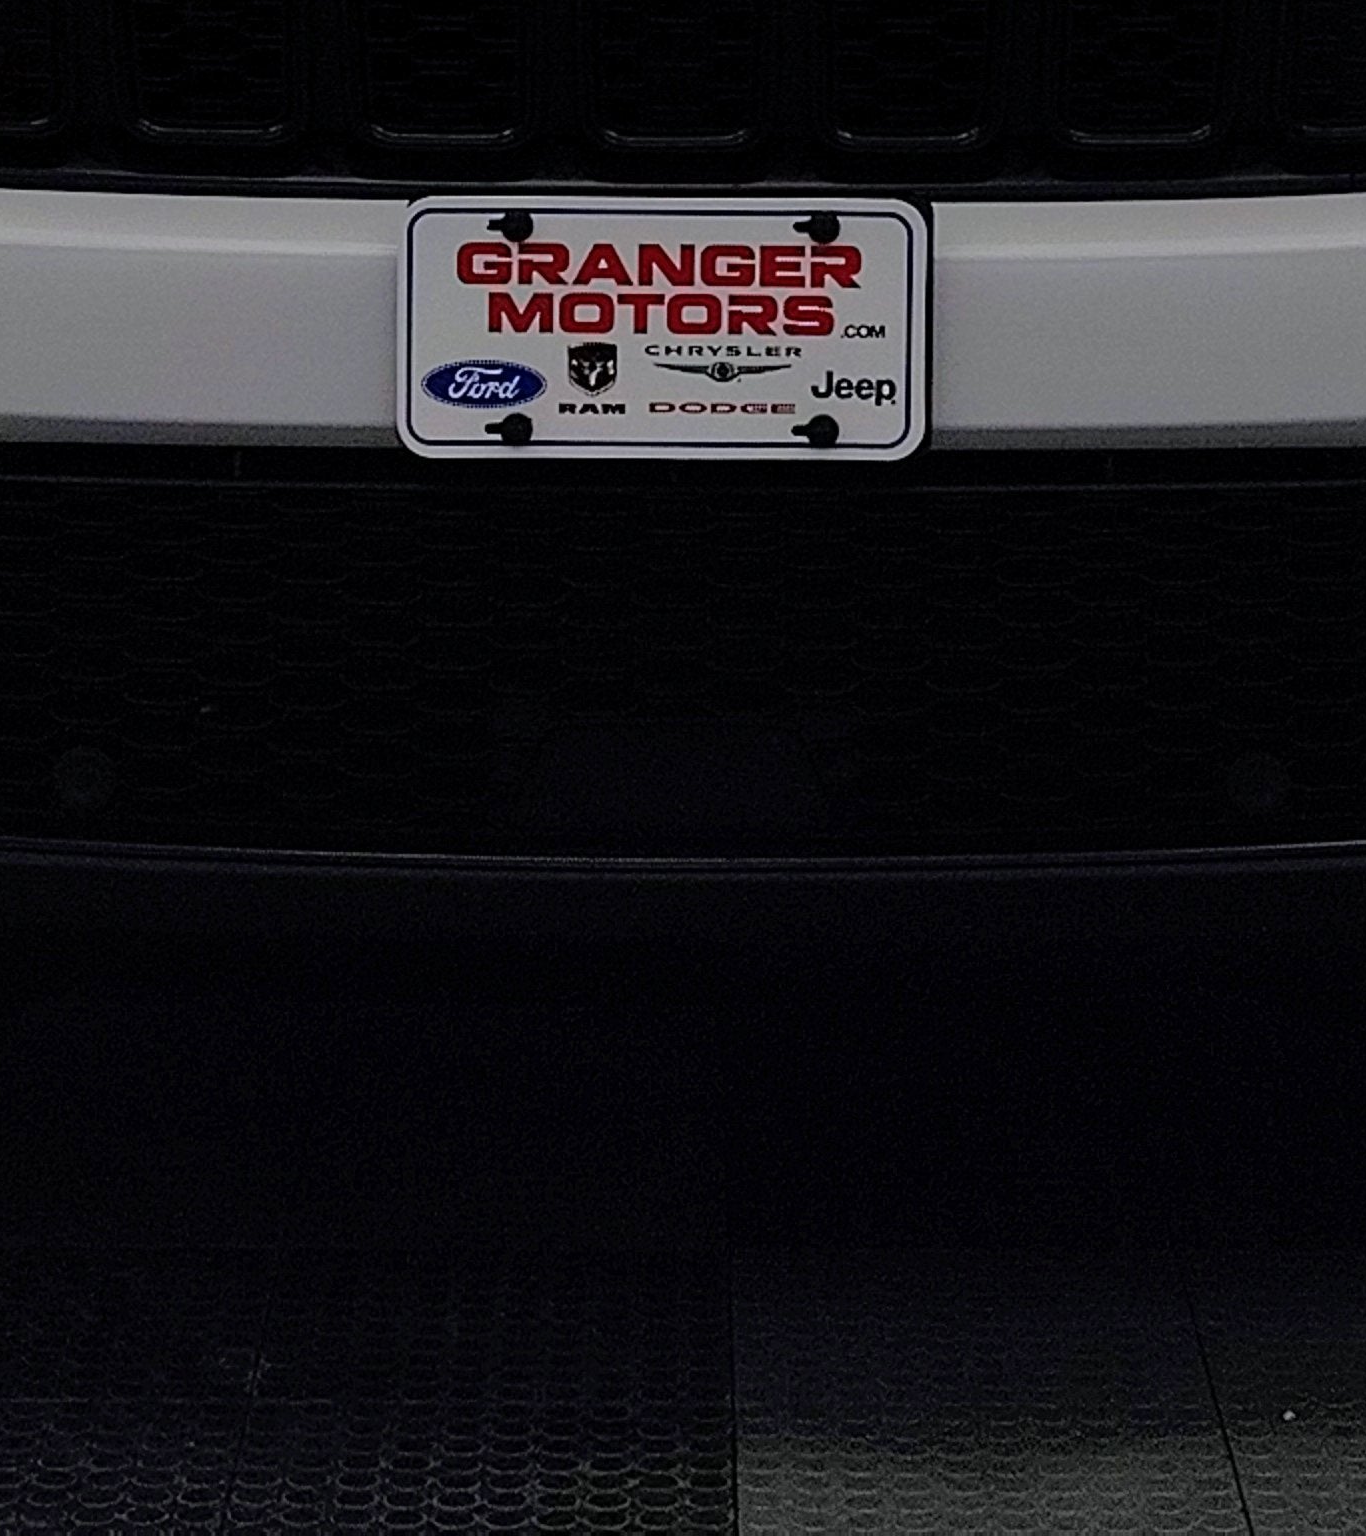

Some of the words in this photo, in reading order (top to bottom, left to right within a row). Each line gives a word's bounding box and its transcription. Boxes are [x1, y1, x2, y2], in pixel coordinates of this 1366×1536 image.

[456, 242, 863, 288] GRANGER
[488, 292, 836, 336] MOTORS
[644, 345, 803, 358] CHRYSLER
[447, 366, 521, 401] Ford
[811, 371, 897, 406] Jeep
[558, 402, 626, 415] RAM
[648, 402, 797, 414] DODGE
